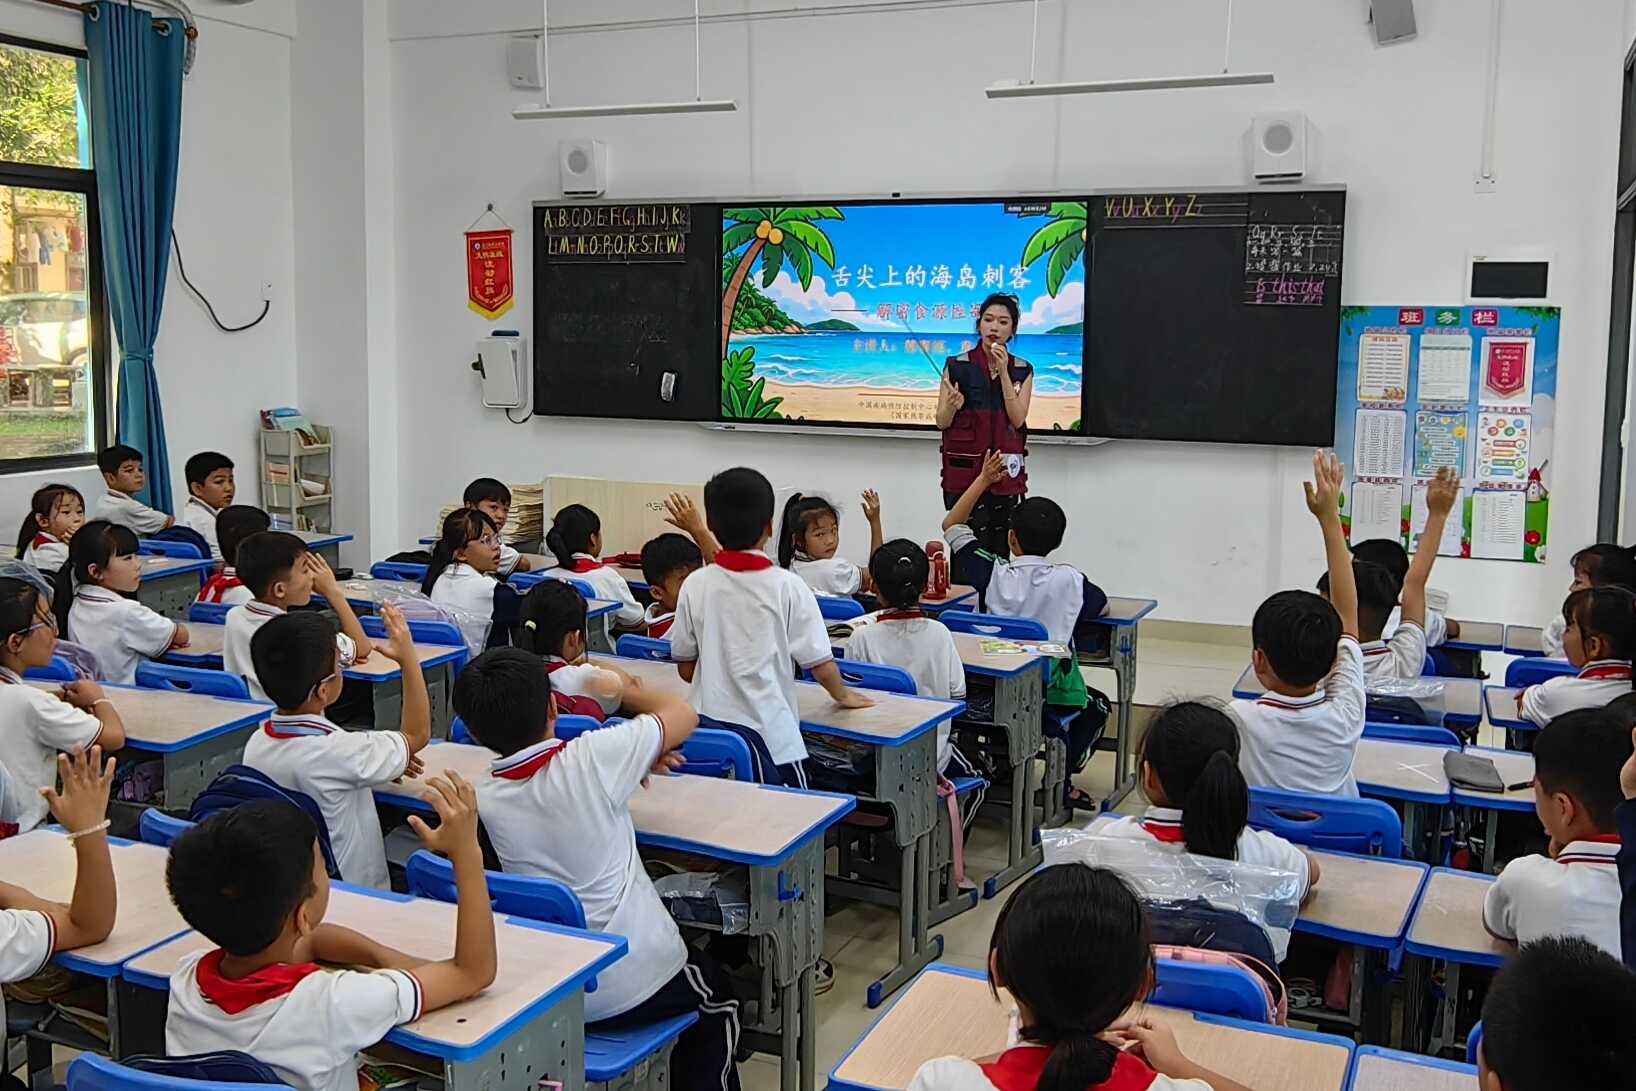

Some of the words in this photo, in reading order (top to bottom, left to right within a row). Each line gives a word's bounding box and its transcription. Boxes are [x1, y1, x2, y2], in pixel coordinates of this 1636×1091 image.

[832, 265, 1032, 289] 舌尖上的海岛刺客
[1400, 312, 1495, 325] 班务栏
[857, 399, 939, 410] 中国疾病预防控制中心
